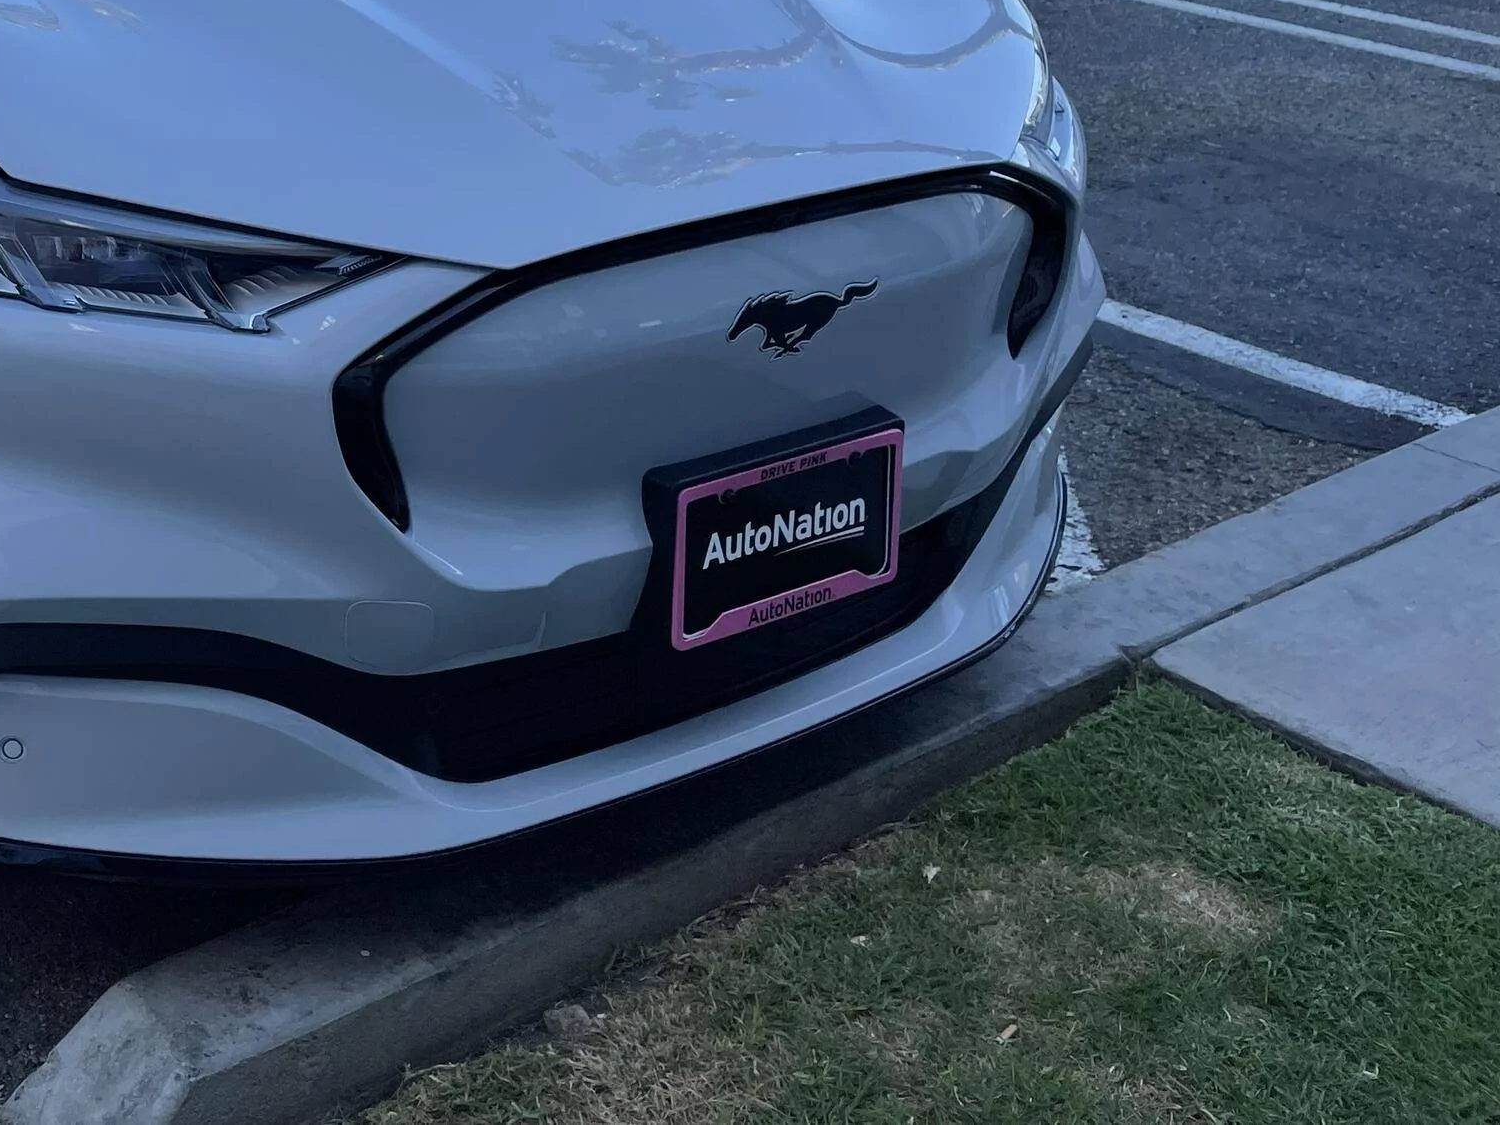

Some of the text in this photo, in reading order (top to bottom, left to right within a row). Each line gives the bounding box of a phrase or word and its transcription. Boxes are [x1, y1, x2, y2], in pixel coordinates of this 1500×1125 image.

[760, 451, 828, 481] DRIVE PINK
[702, 497, 866, 570] AutoNation
[748, 586, 833, 627] AutoNation
